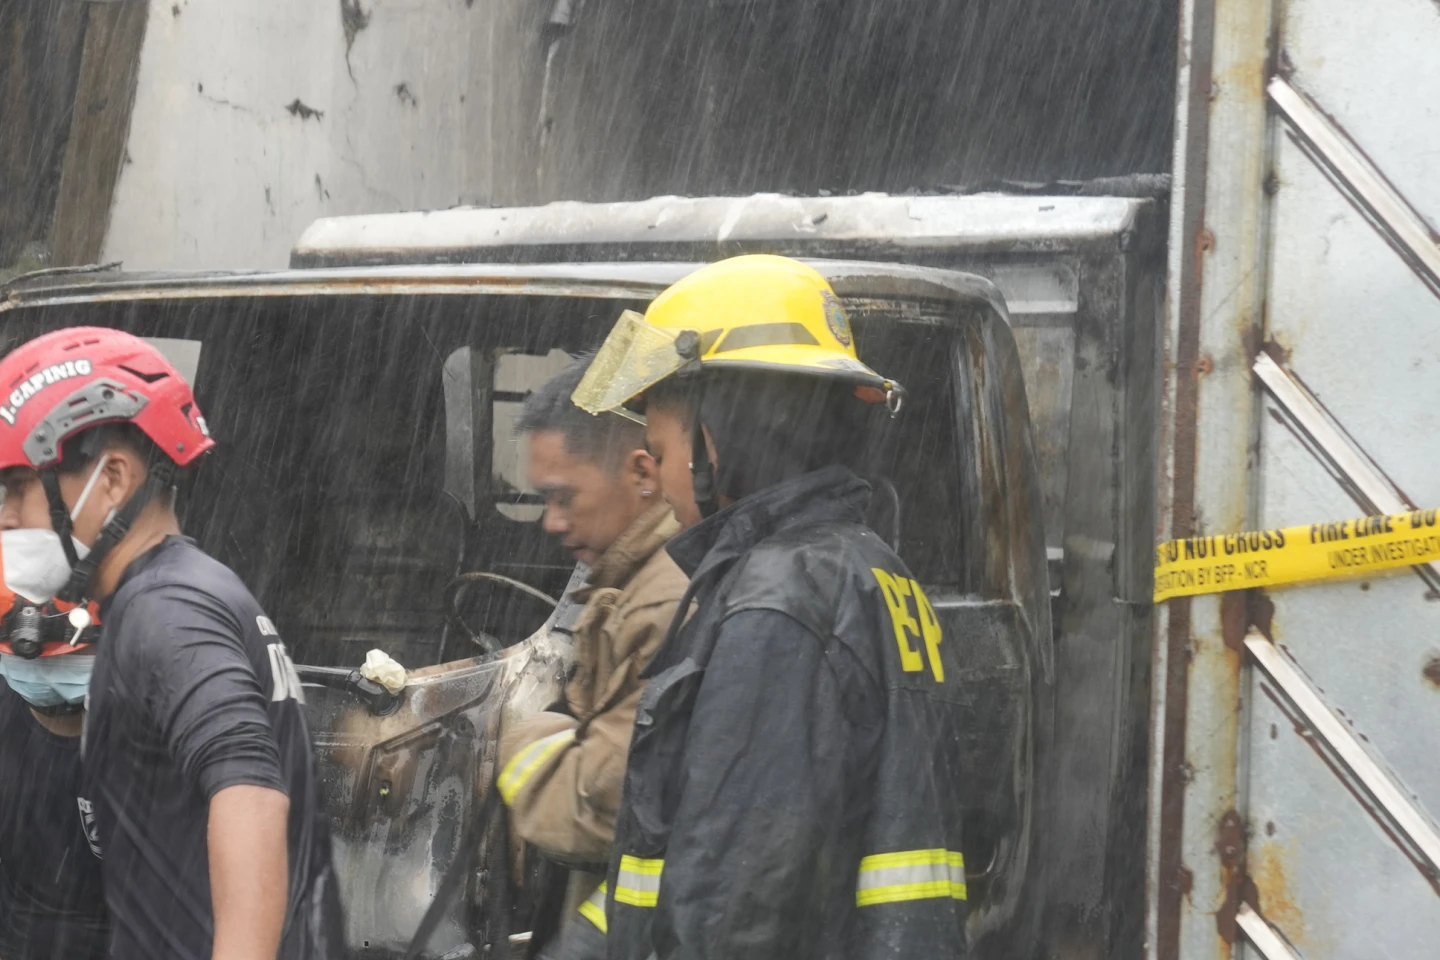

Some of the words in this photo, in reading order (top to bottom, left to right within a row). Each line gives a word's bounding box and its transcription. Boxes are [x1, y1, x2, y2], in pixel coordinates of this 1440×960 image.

[1224, 529, 1286, 556] CROSS
[1311, 522, 1349, 545] FIRE
[1355, 515, 1394, 538] LINE
[1198, 567, 1212, 585] BY
[1327, 545, 1369, 569] UNDER
